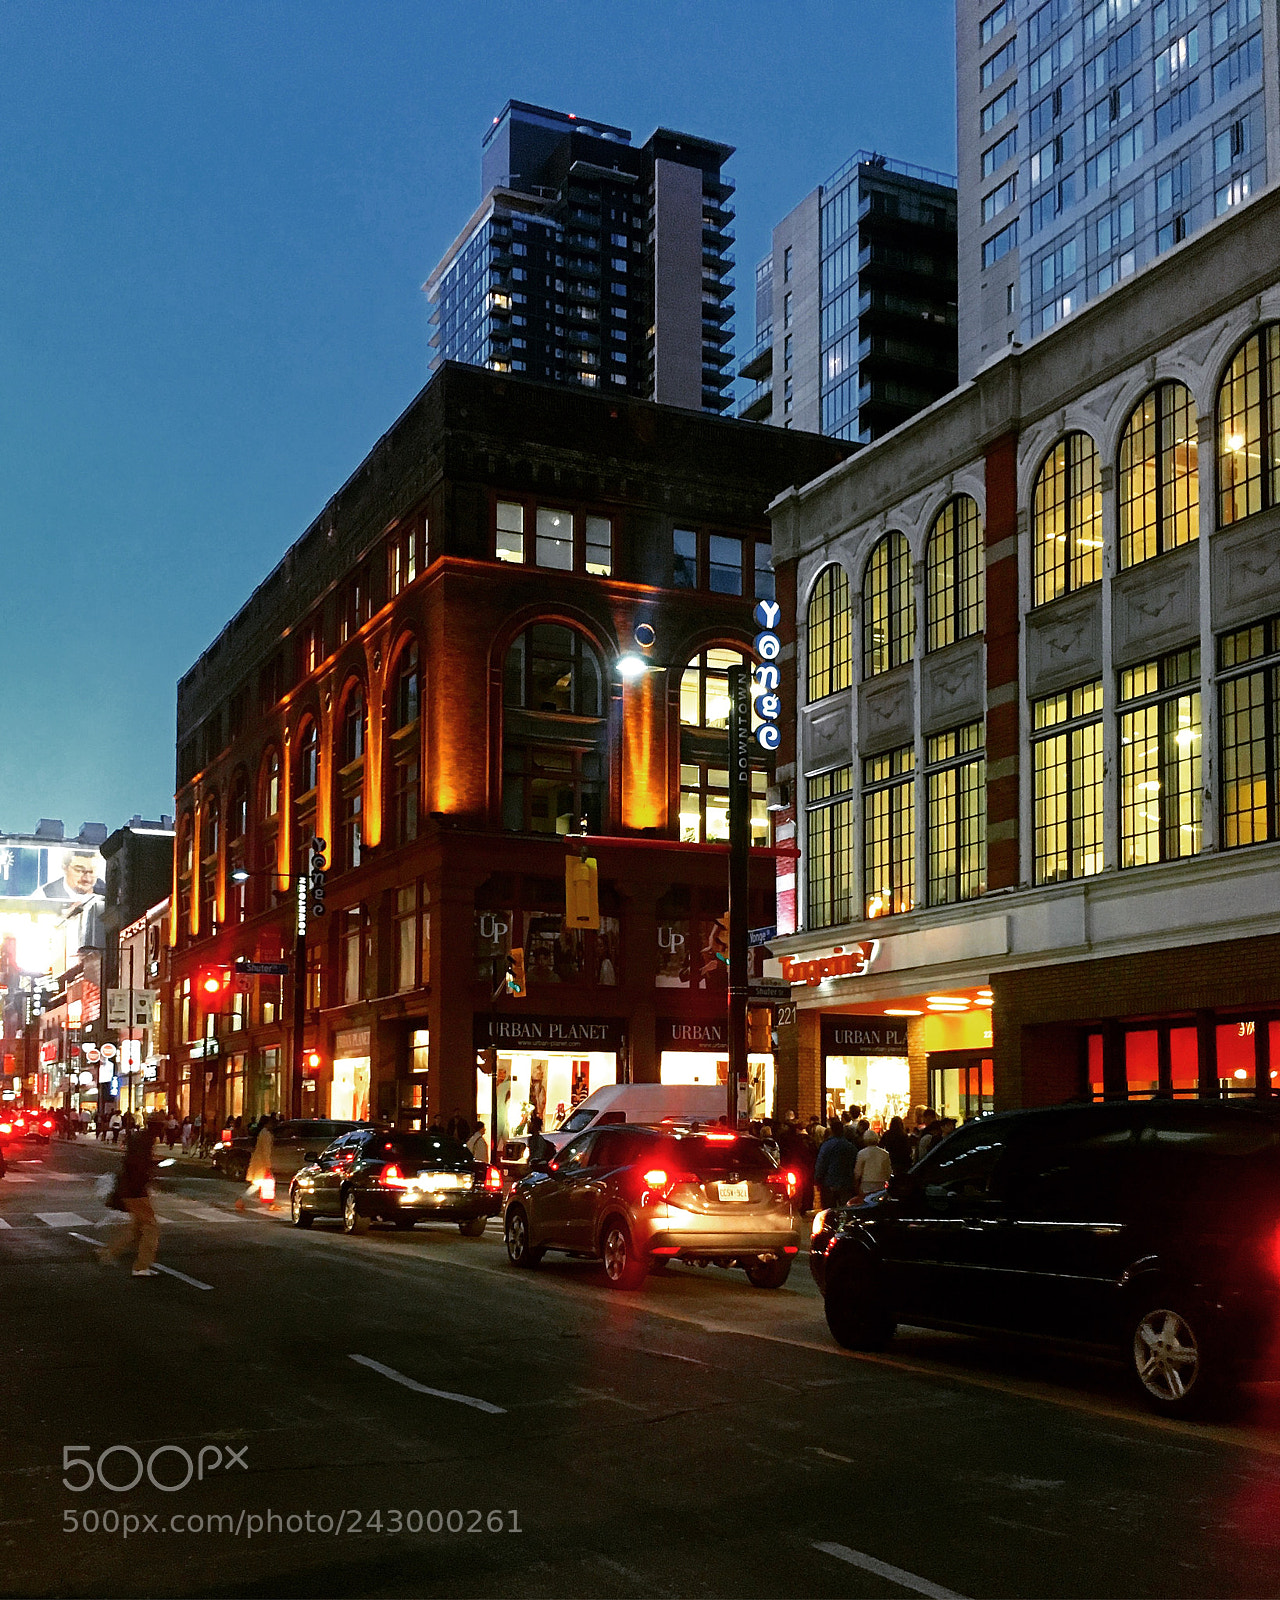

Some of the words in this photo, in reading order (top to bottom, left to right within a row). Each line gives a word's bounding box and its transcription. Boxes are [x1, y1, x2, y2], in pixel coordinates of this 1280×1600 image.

[754, 599, 781, 751] Yonge
[738, 673, 748, 782] DOWNTOWN
[312, 837, 326, 918] Yonge
[480, 915, 508, 944] UP
[657, 927, 685, 954] UP
[749, 931, 767, 944] Yonge
[778, 947, 867, 987] Tangerine
[778, 1006, 796, 1025] 221
[549, 1023, 609, 1040] PLANET
[671, 1024, 722, 1040] URBAN
[834, 1029, 881, 1044] URBAN
